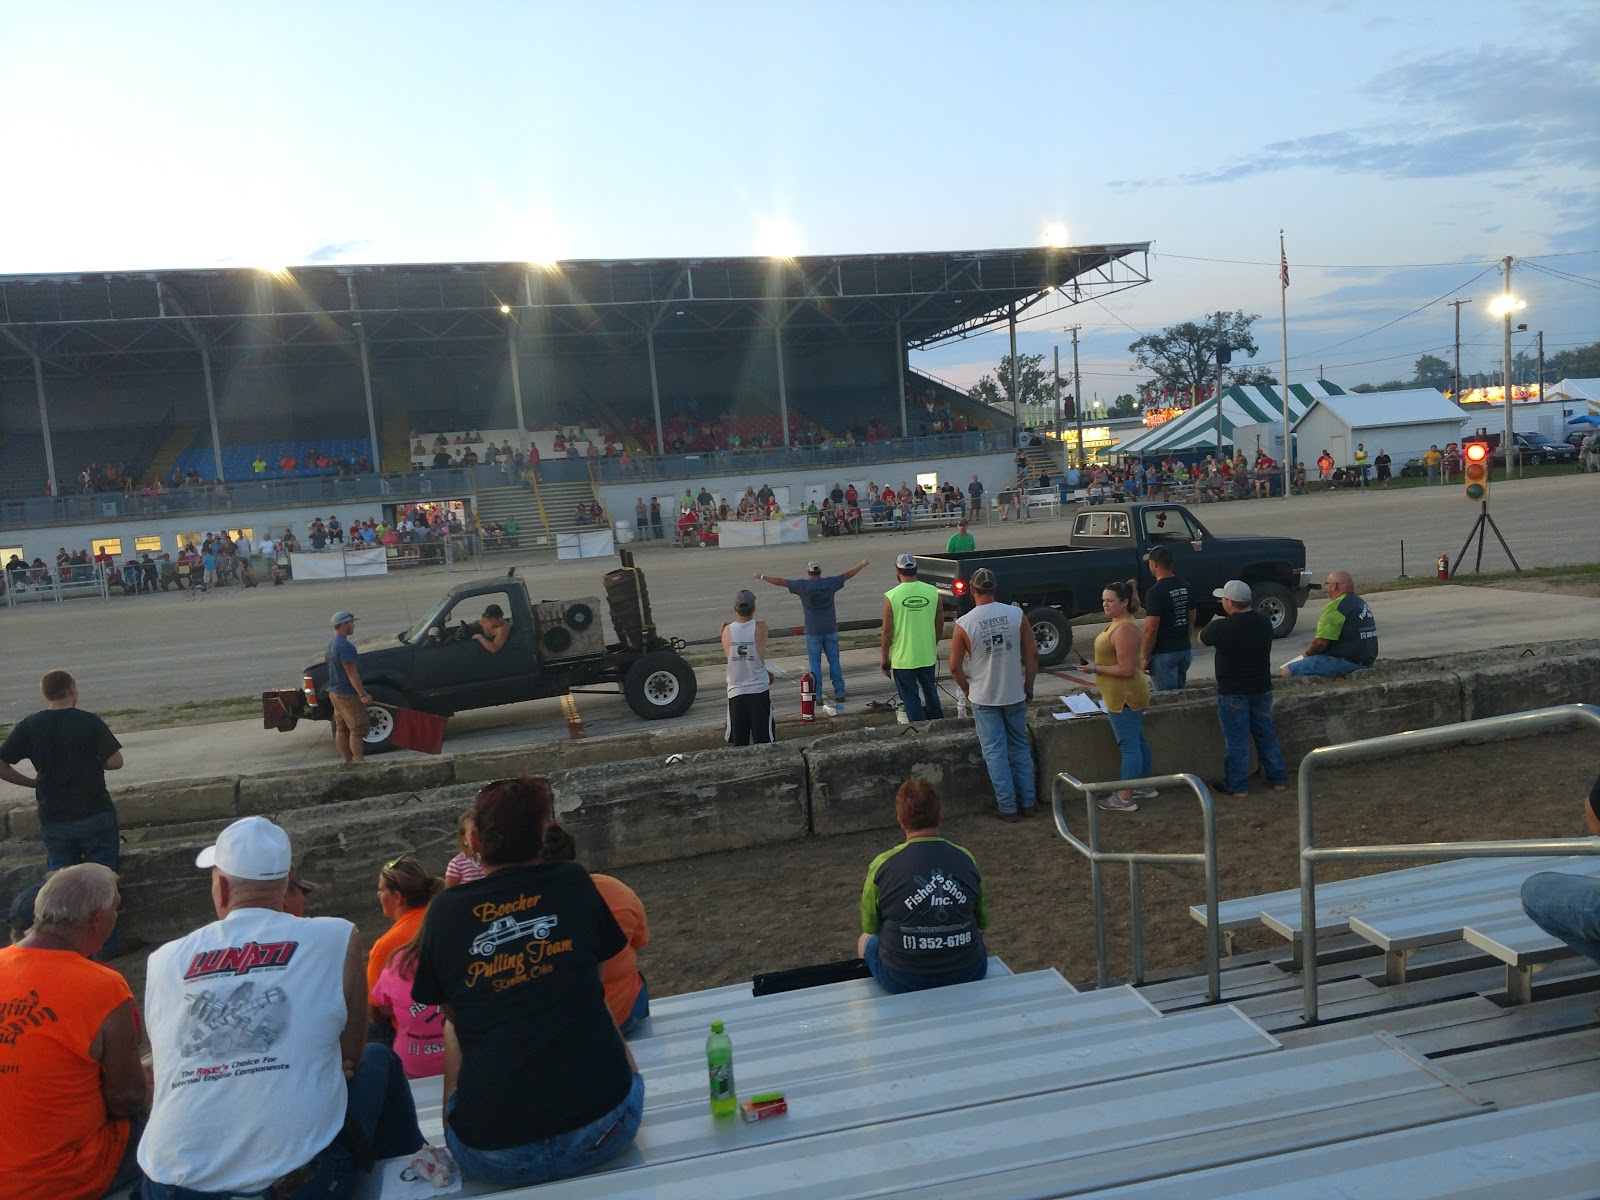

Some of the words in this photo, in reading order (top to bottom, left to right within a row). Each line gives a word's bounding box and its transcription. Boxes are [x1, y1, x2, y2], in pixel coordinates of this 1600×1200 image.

[903, 874, 945, 911] Fisher's
[942, 879, 968, 905] Shop
[930, 894, 954, 907] Inc.
[918, 931, 972, 950] 352-6798
[183, 940, 299, 980] LUNATI
[465, 952, 526, 988] Pulling
[525, 938, 573, 964] Team
[181, 1070, 195, 1079] The
[196, 1063, 229, 1077] Racer's
[231, 1058, 260, 1069] Choice
[262, 1056, 279, 1064] For
[203, 1071, 232, 1083] Engine
[234, 1062, 291, 1077] Components
